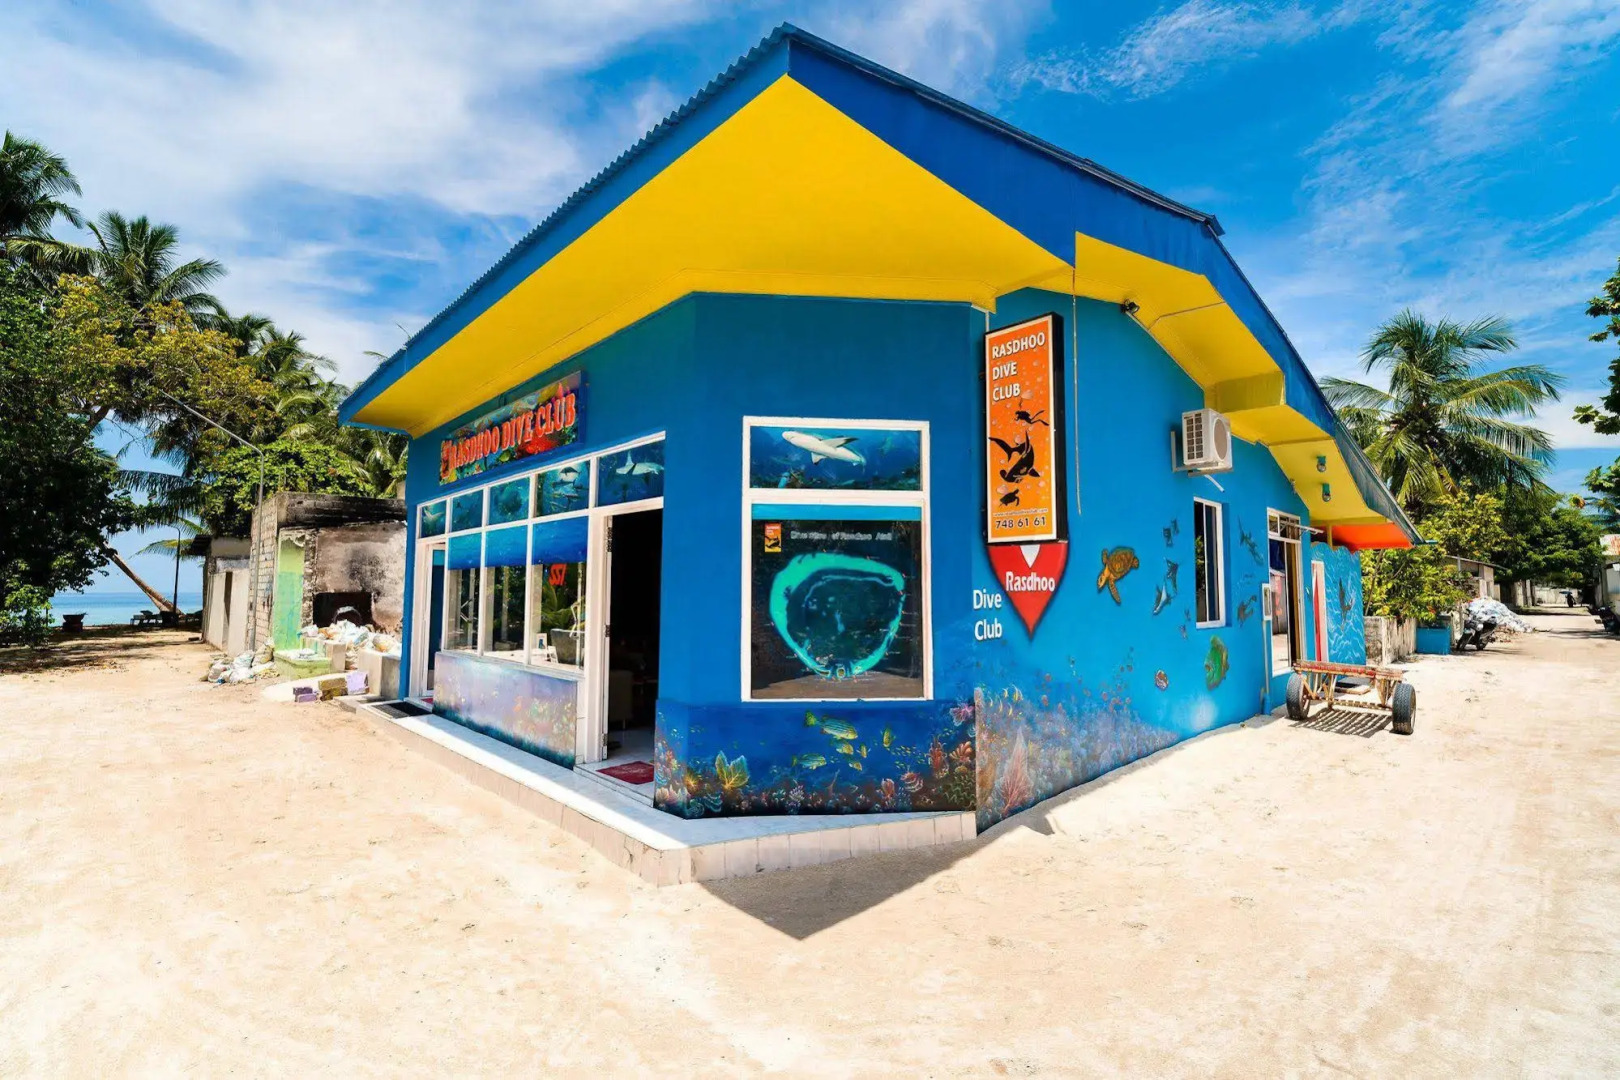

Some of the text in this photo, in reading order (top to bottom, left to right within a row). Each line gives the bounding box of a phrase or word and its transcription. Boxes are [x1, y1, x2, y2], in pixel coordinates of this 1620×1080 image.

[992, 332, 1045, 359] RASDHOO
[992, 361, 1018, 381] DIVE
[992, 383, 1020, 401] CLUB
[449, 393, 575, 469] RASDHOO DIVE CLUB
[995, 516, 1045, 529] 748 61 61
[1005, 571, 1055, 591] Rasdhoo
[973, 588, 1002, 610] Dive
[974, 617, 1002, 640] Club
